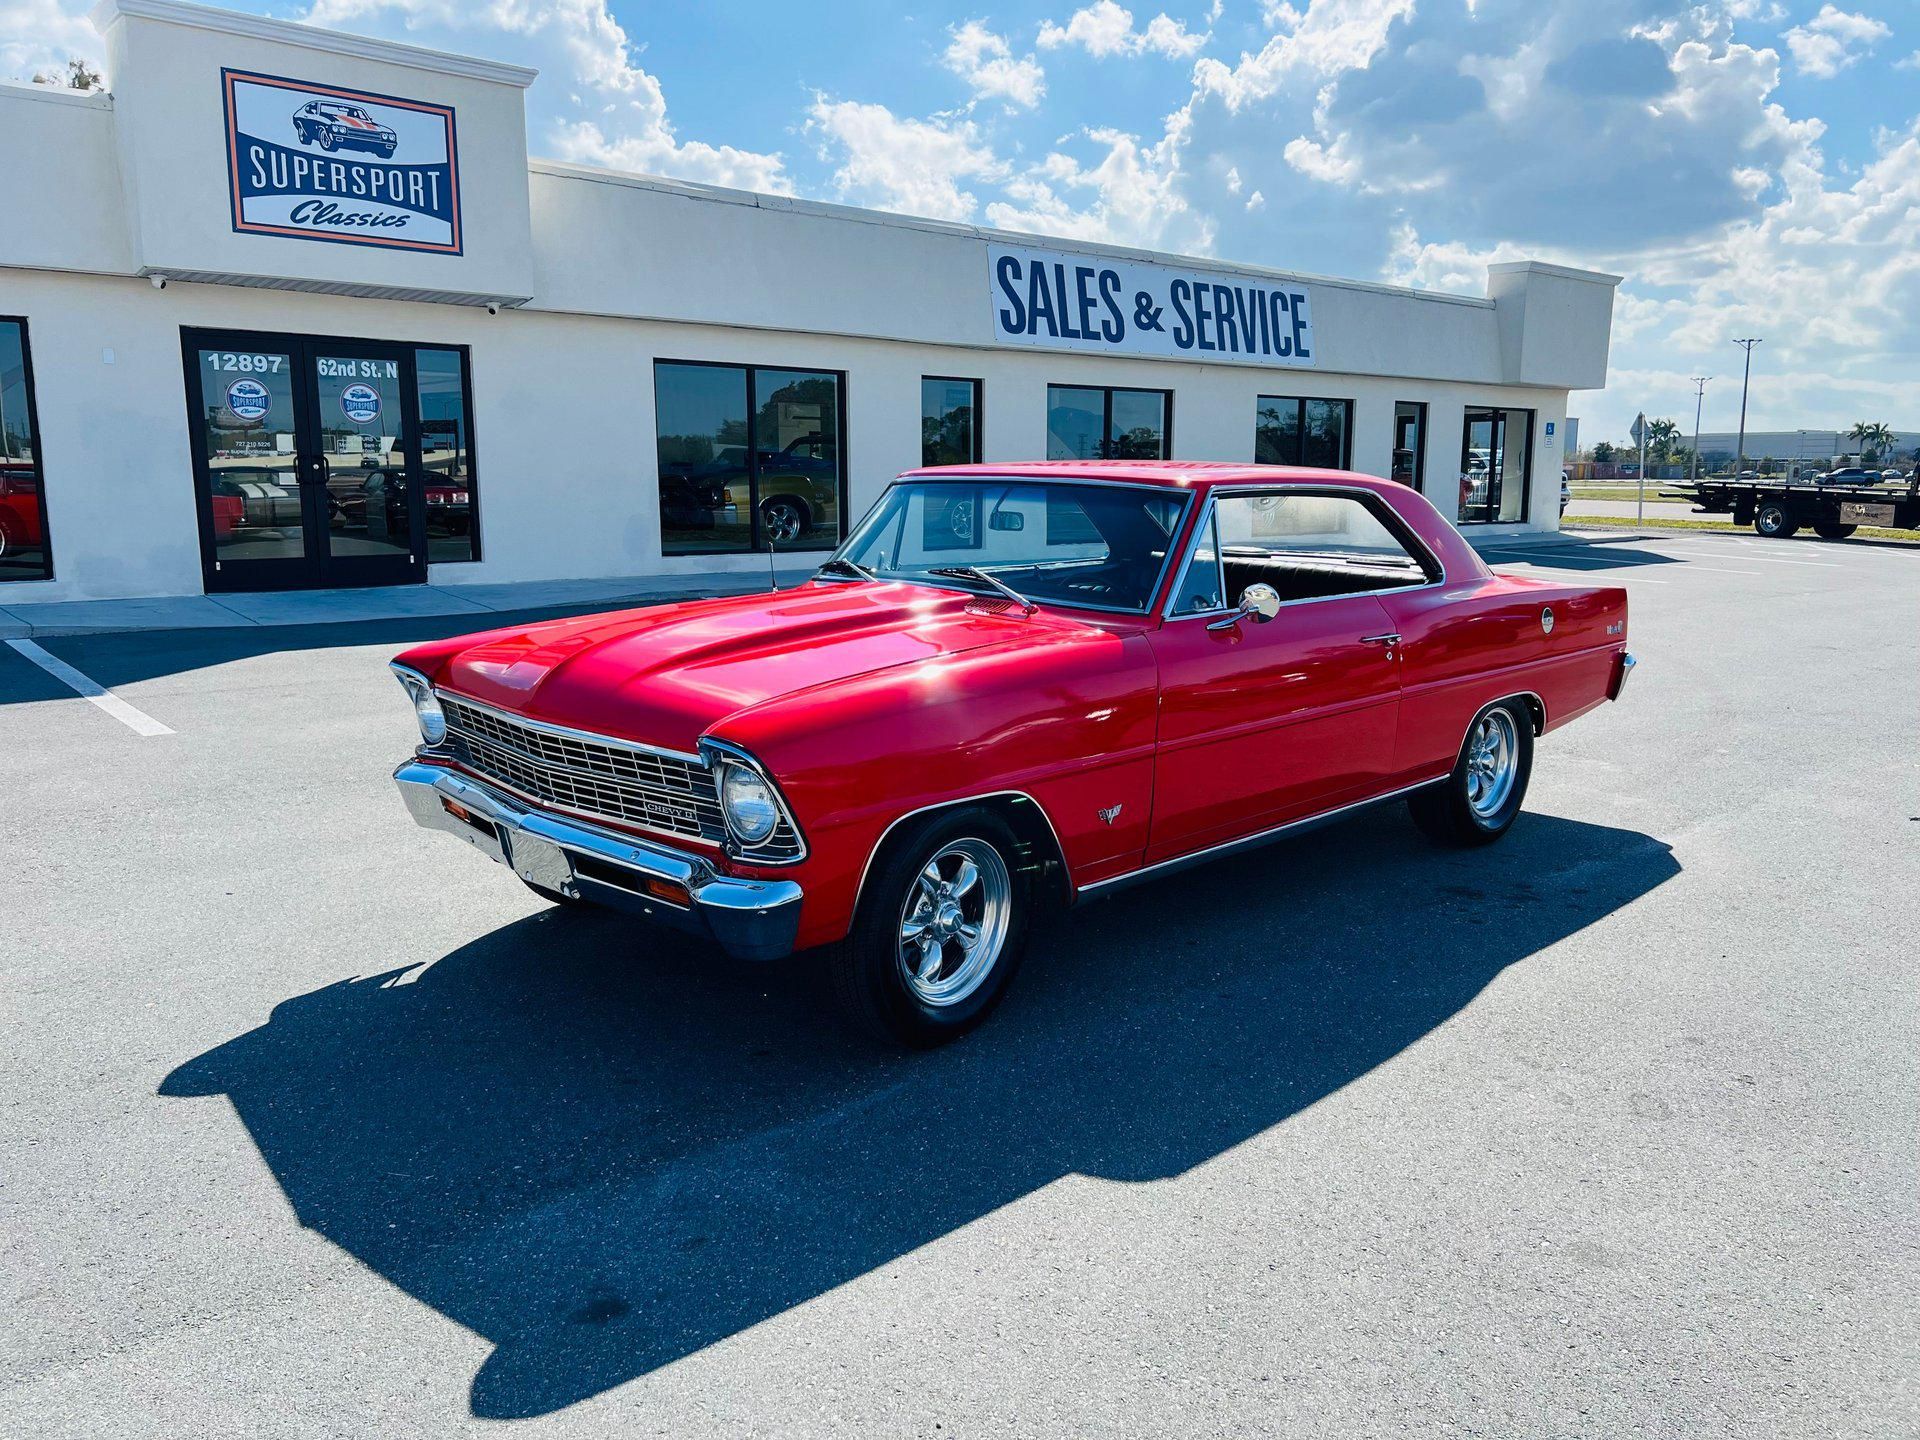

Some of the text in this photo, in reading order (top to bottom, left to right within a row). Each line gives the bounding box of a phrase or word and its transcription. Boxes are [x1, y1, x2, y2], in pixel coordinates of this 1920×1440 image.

[250, 145, 440, 211] SUPERSPORT
[289, 199, 411, 228] Classics
[996, 255, 1310, 358] SALES & SERVICE
[207, 352, 282, 373] 12897
[318, 359, 398, 379] 62nd St. N
[232, 396, 266, 407] SUPERSPORT
[647, 803, 682, 816] CHEVY
